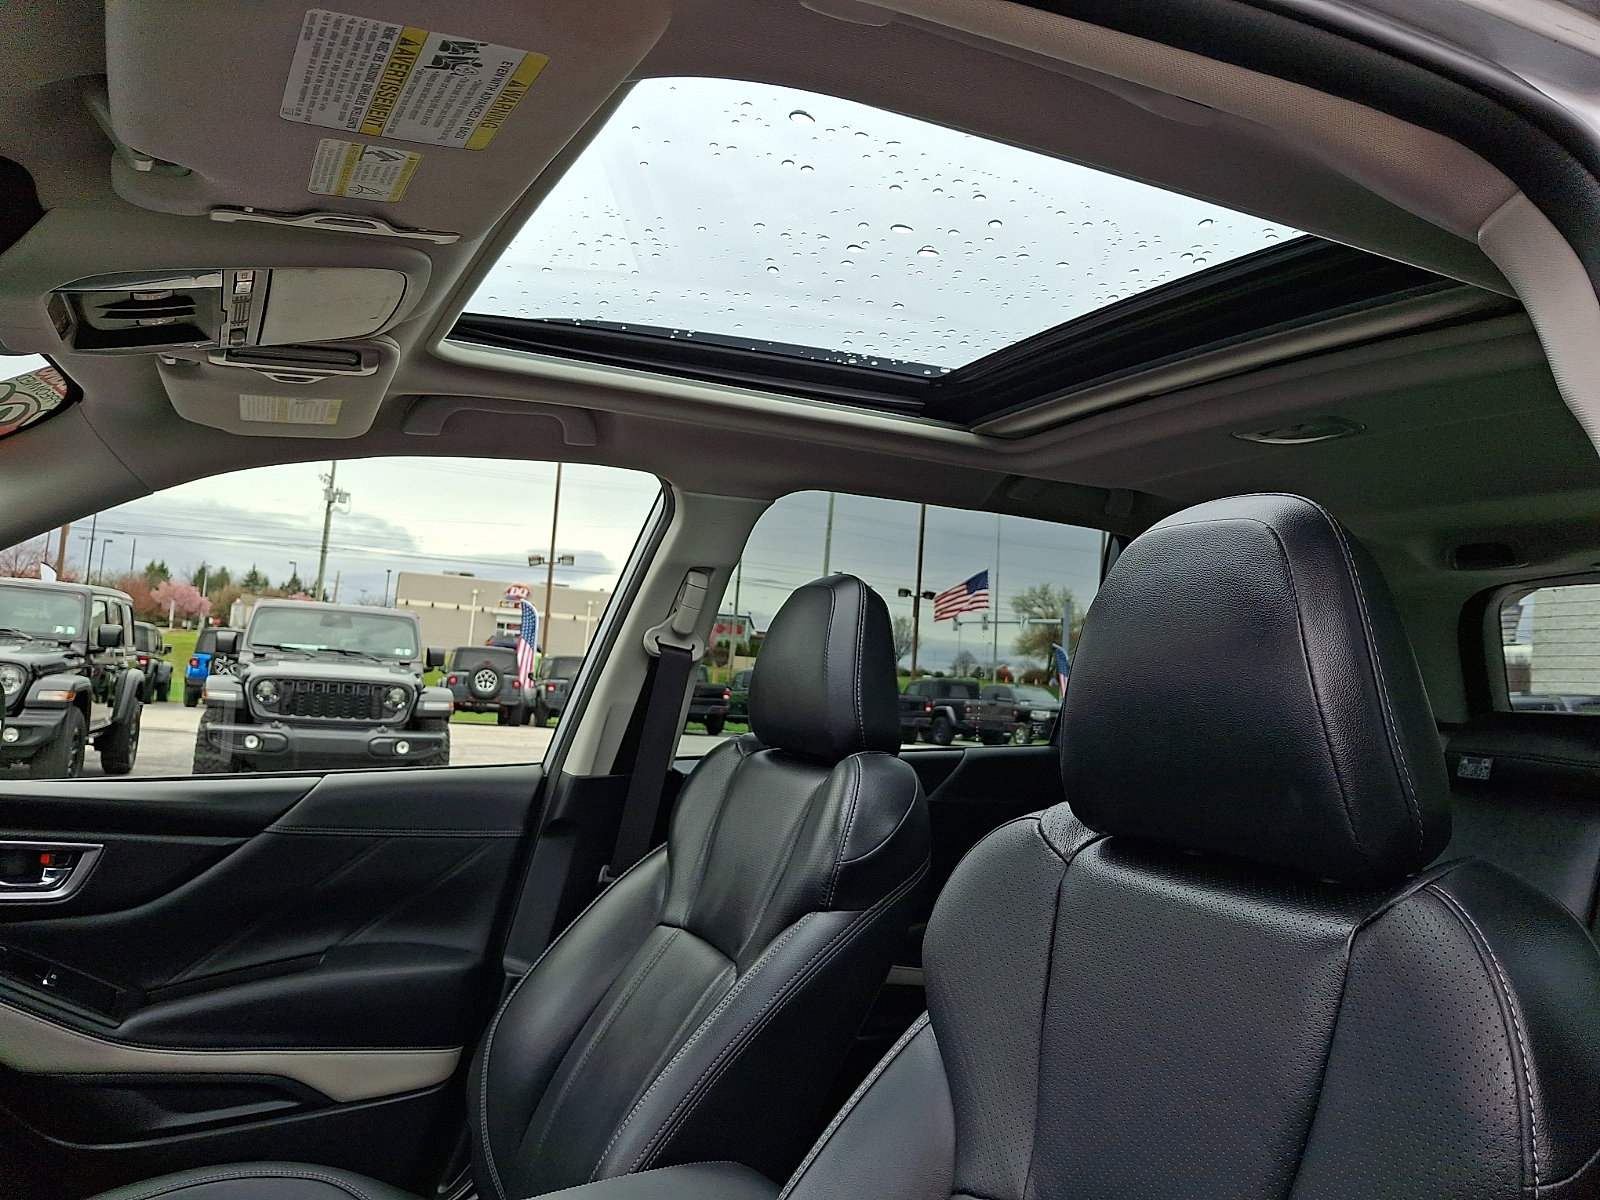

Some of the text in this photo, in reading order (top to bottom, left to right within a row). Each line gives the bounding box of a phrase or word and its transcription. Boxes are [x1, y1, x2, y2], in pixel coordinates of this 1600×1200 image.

[493, 60, 514, 77] EVEN
[363, 47, 416, 128] AVERTISSEMENT
[484, 76, 503, 91] WITH
[467, 91, 493, 118] ADVANCED
[479, 88, 522, 129] WARNING
[510, 586, 529, 598] DQ
